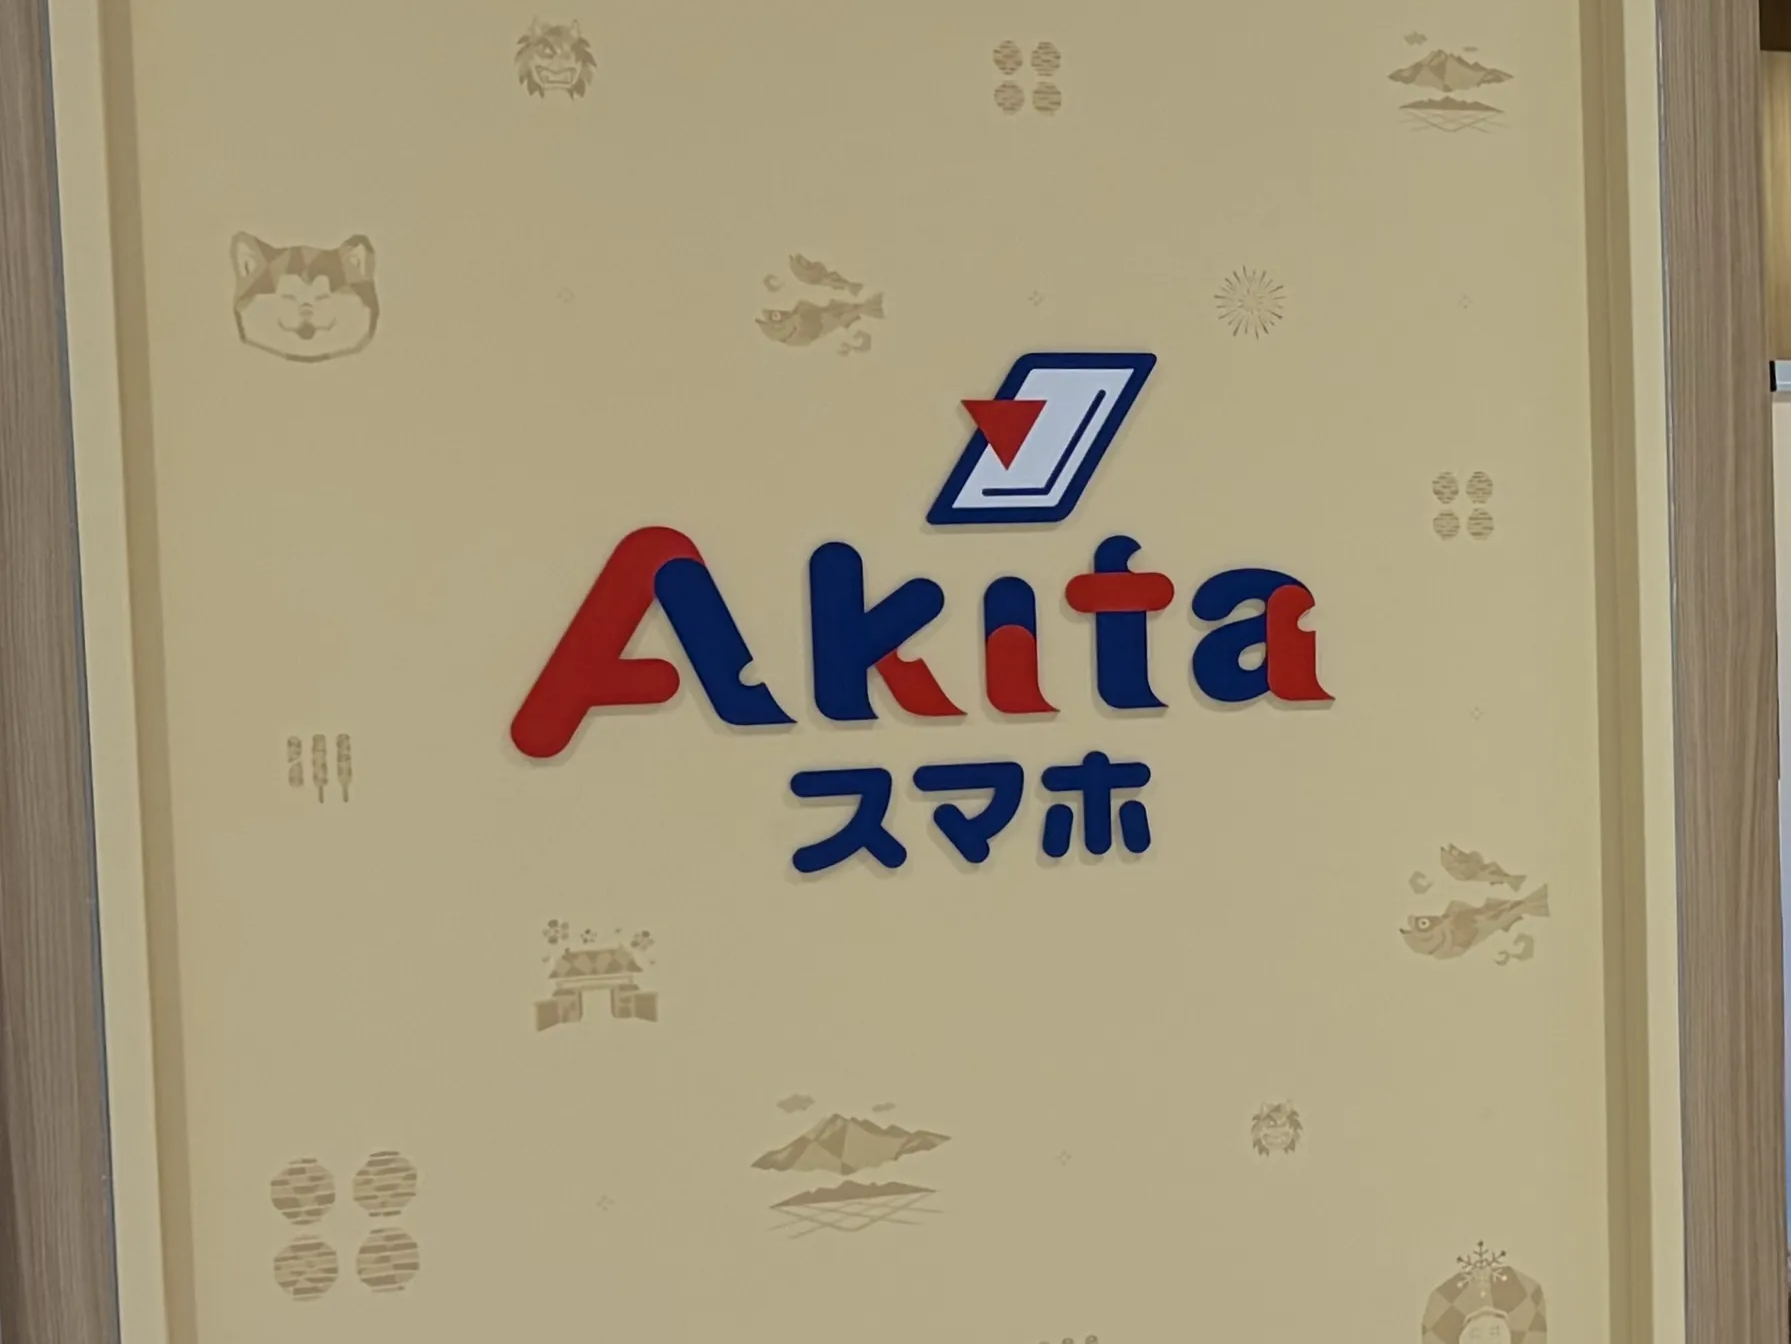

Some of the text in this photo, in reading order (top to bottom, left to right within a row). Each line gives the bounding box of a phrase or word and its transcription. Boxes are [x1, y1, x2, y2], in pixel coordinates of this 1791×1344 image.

[510, 525, 1336, 758] Akita
[789, 750, 1152, 873] スマホ
